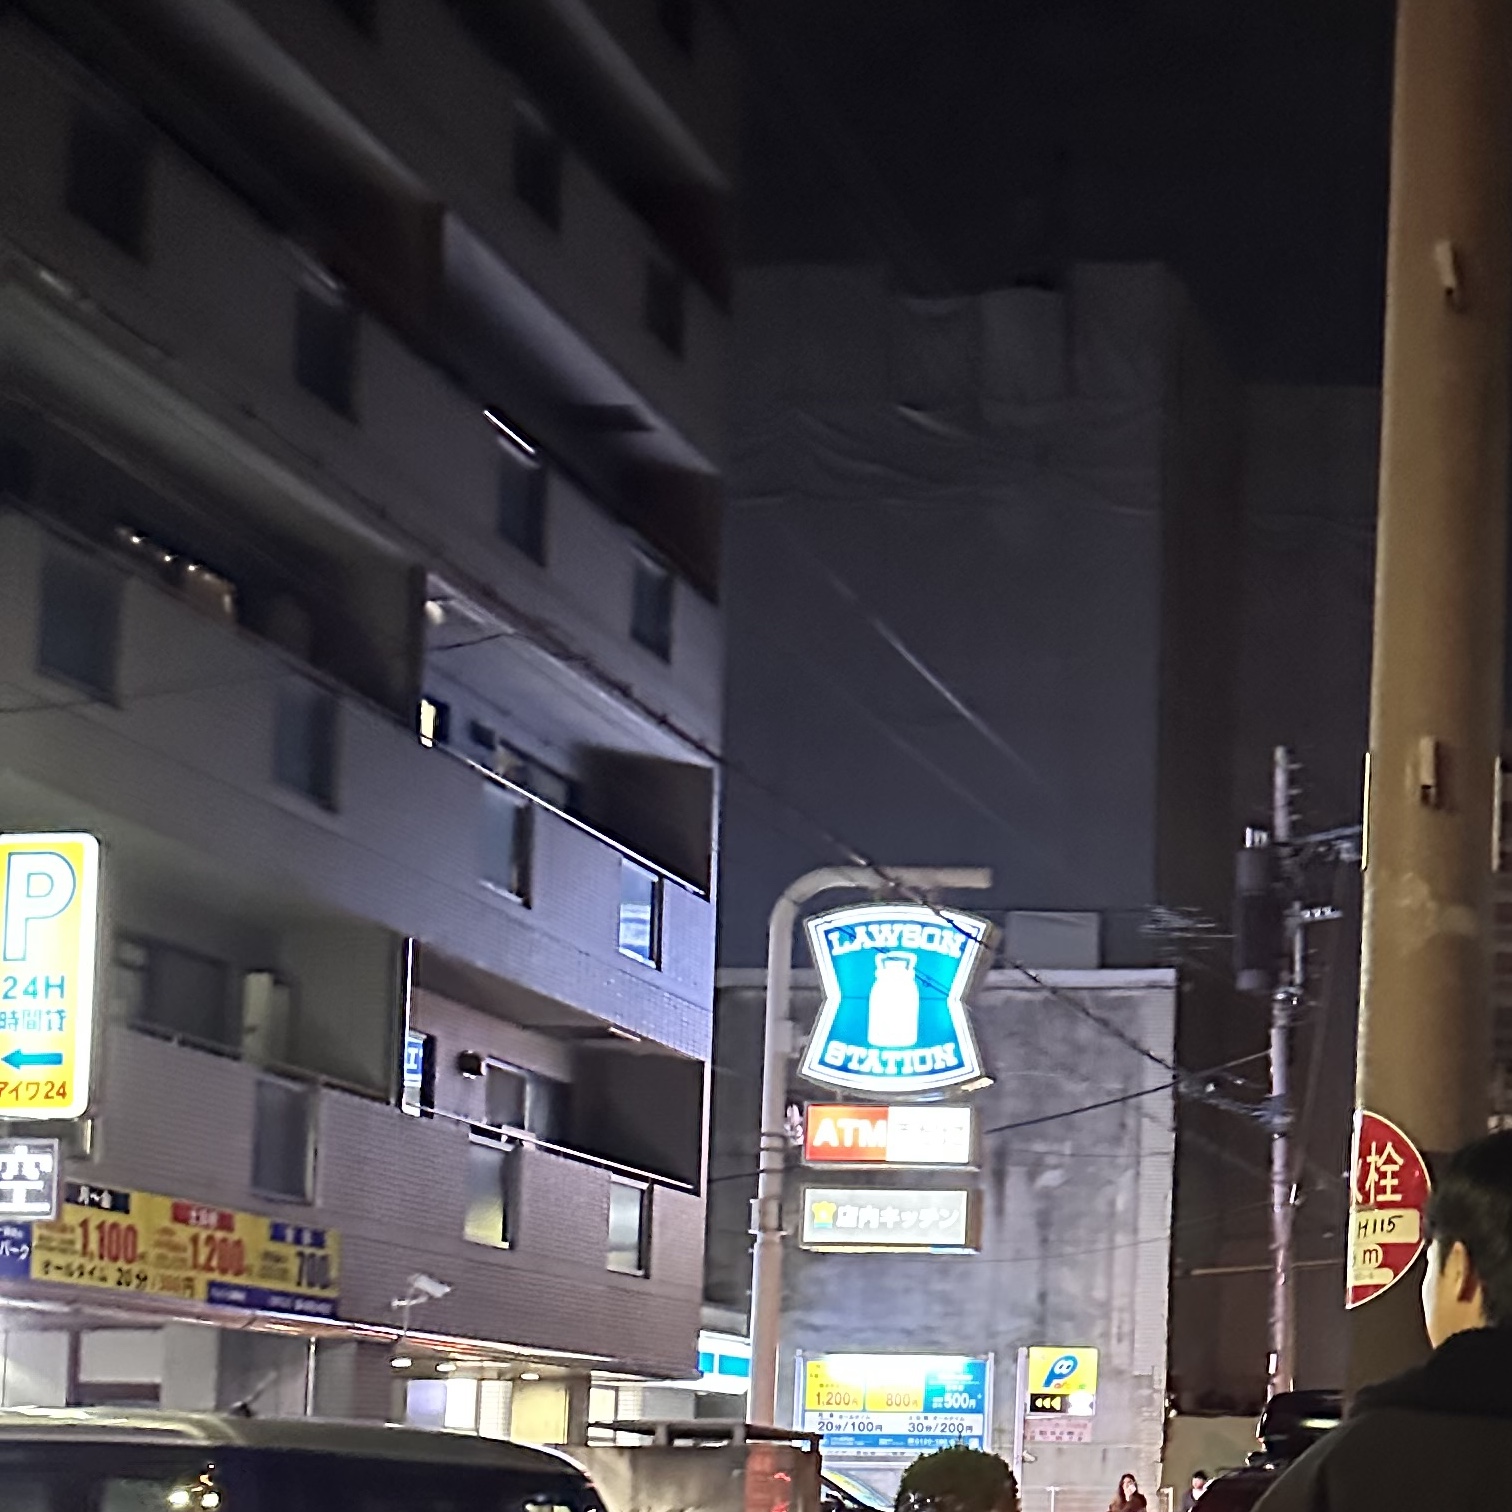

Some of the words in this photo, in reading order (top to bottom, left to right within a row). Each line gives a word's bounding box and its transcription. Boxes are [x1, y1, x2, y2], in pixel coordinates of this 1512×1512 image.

[3, 851, 76, 962] P
[827, 923, 967, 959] LAWSON
[2, 975, 65, 1000] 24H
[824, 1040, 959, 1075] STATION
[813, 1117, 887, 1147] ATM
[1356, 1141, 1404, 1204] 栓
[836, 1204, 960, 1229] 店内キッチン
[1357, 1215, 1404, 1239] H115
